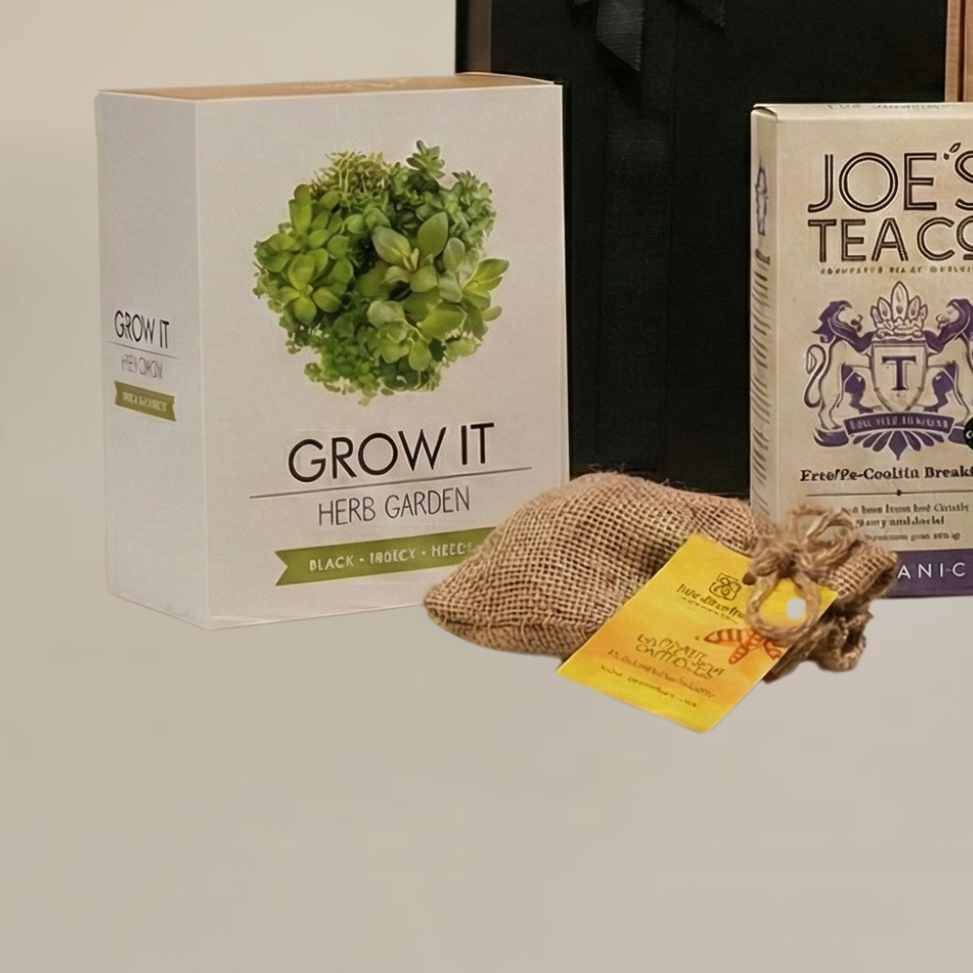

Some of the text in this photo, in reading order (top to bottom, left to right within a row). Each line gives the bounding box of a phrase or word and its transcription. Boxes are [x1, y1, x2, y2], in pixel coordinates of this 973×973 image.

[807, 217, 909, 263] TEA
[114, 309, 170, 349] GROW IT
[881, 355, 917, 391] T
[287, 422, 496, 483] GROW IT
[318, 486, 471, 527] HERB GARDEN
[309, 555, 354, 571] BLACK
